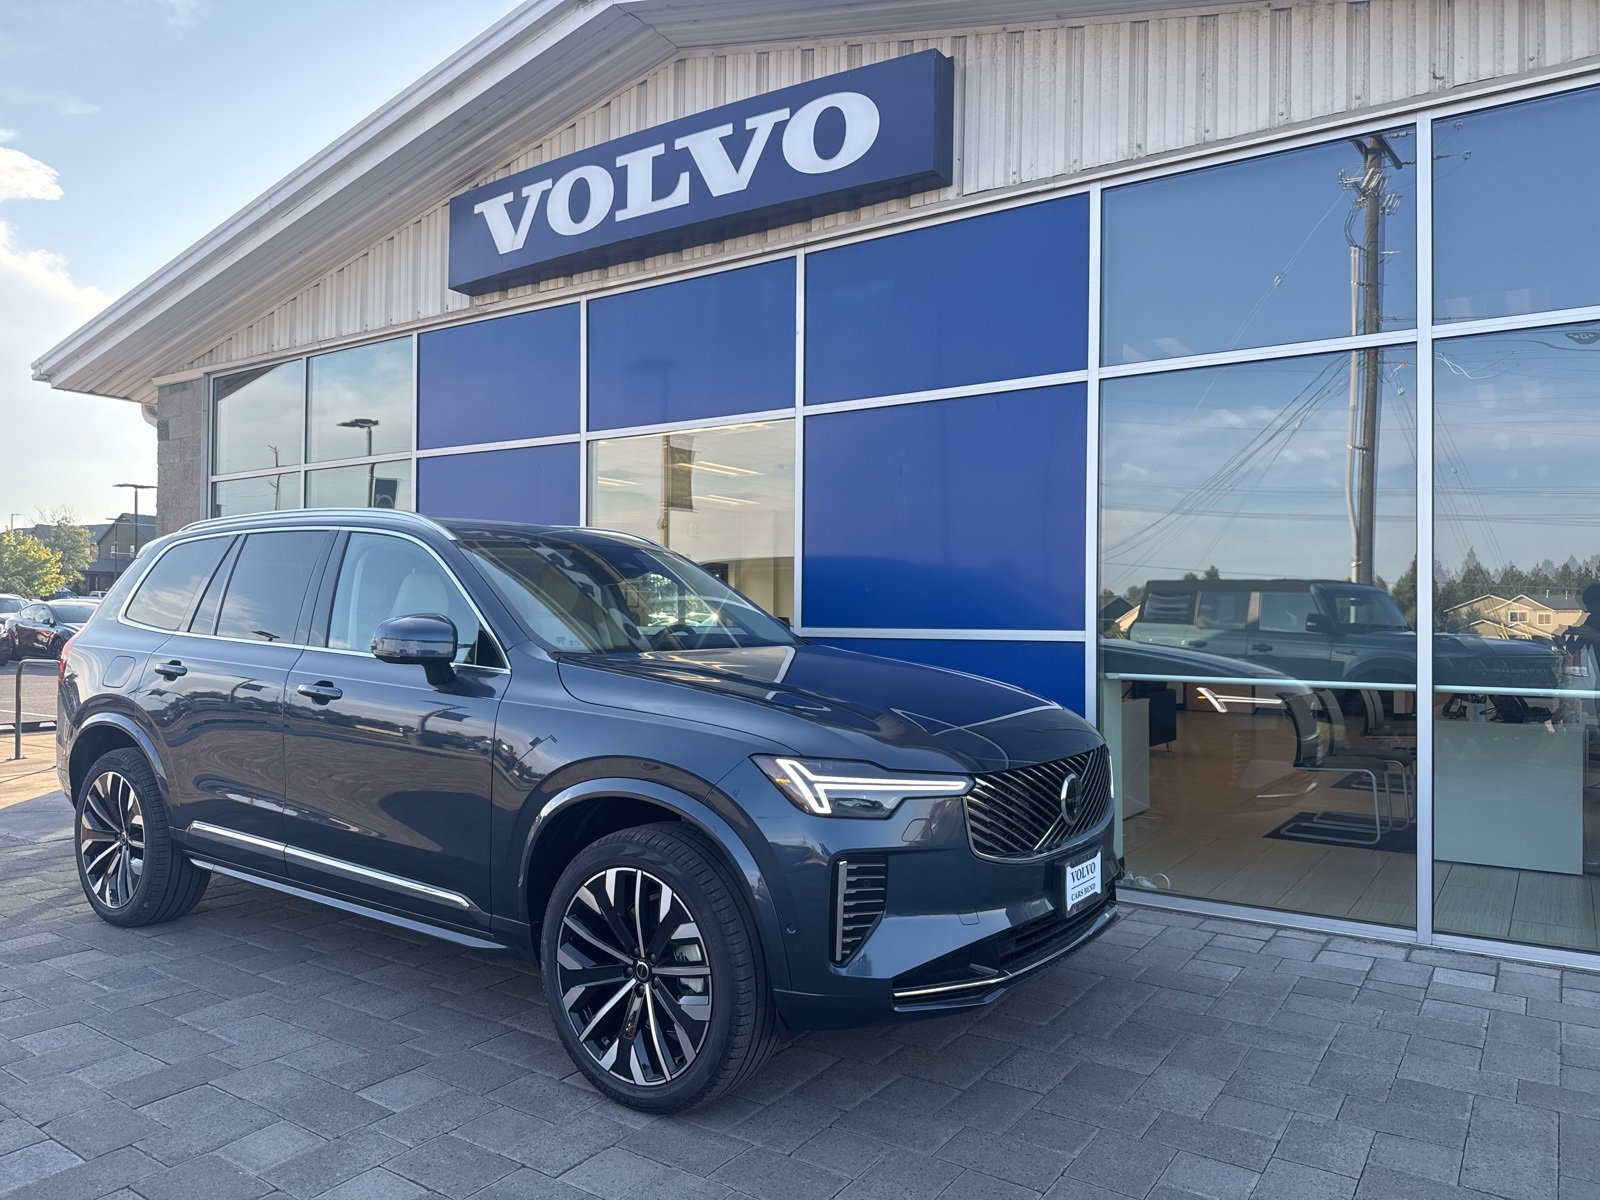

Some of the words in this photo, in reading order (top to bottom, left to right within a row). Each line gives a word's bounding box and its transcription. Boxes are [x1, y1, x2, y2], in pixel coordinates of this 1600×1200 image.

[474, 91, 880, 255] VOLVO
[1071, 862, 1096, 883] VOLVO
[1071, 889, 1084, 901] CARS
[1084, 883, 1096, 895] BEND
